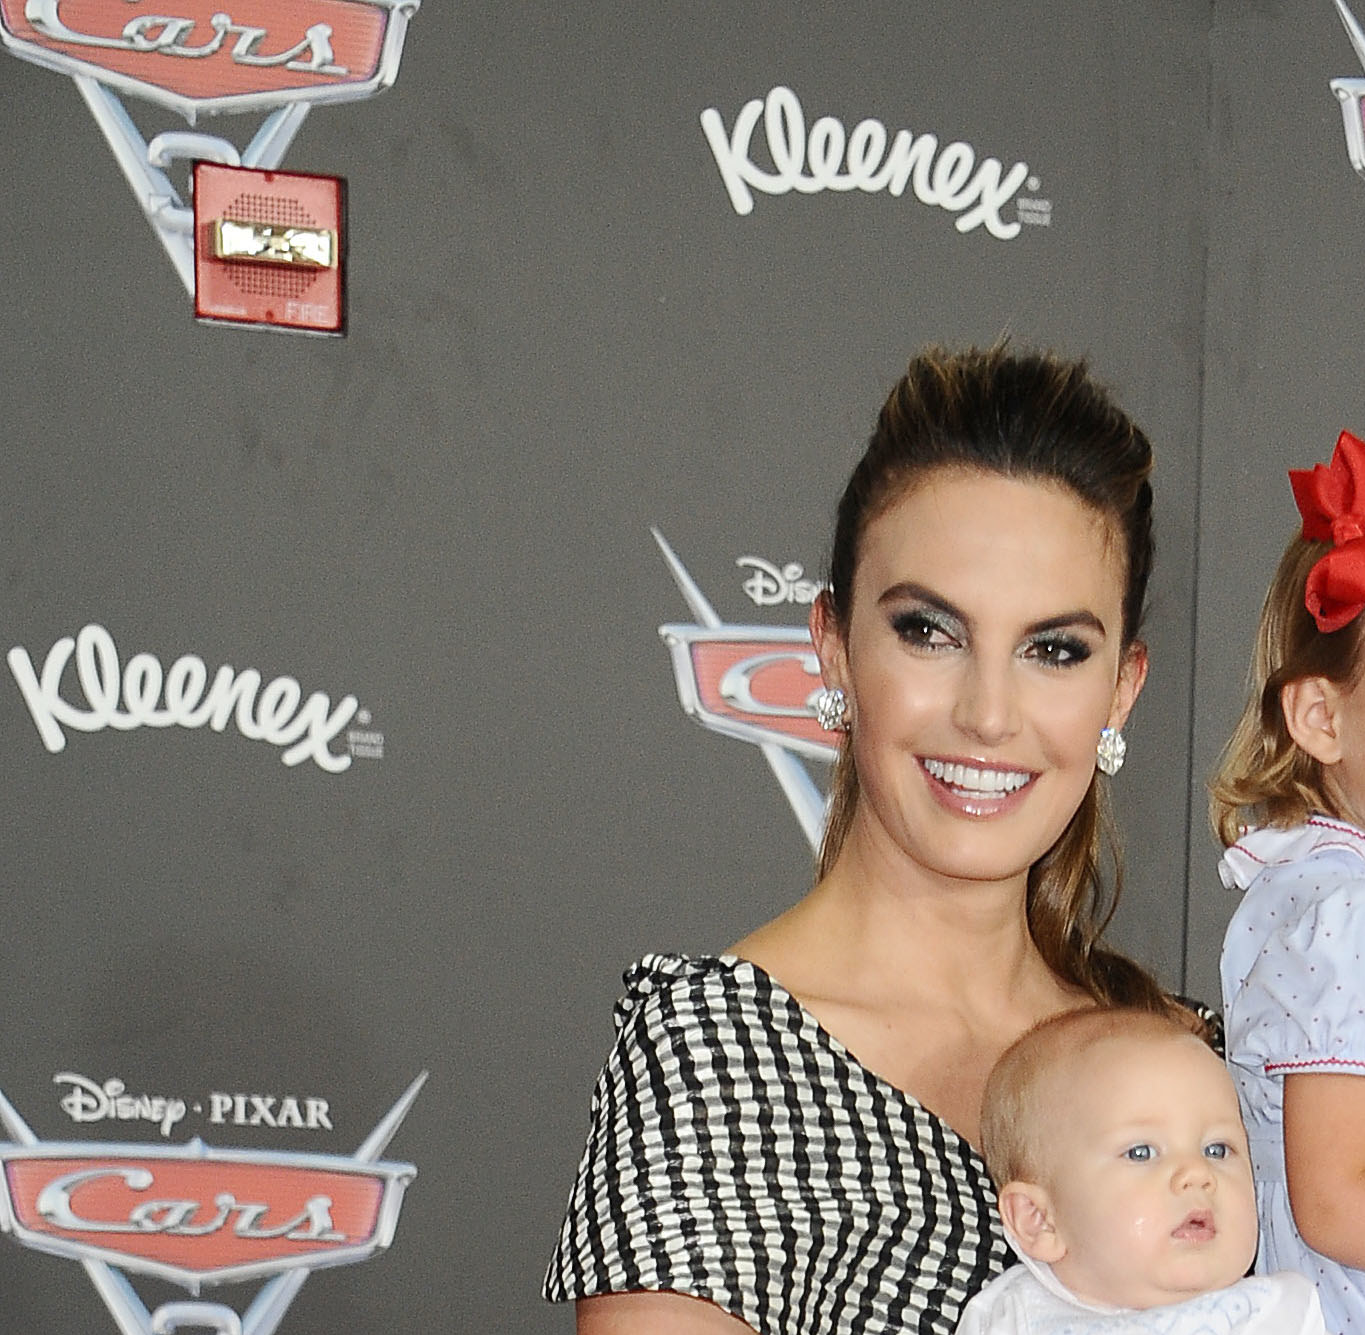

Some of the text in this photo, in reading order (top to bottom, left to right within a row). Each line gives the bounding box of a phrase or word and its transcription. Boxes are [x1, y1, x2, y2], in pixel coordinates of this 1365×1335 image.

[24, 0, 348, 75] Cars
[700, 86, 1028, 239] Kleenex
[8, 624, 357, 772] Kleenex
[54, 1072, 333, 1137] Disney PIXAR
[37, 1166, 346, 1241] Cars
